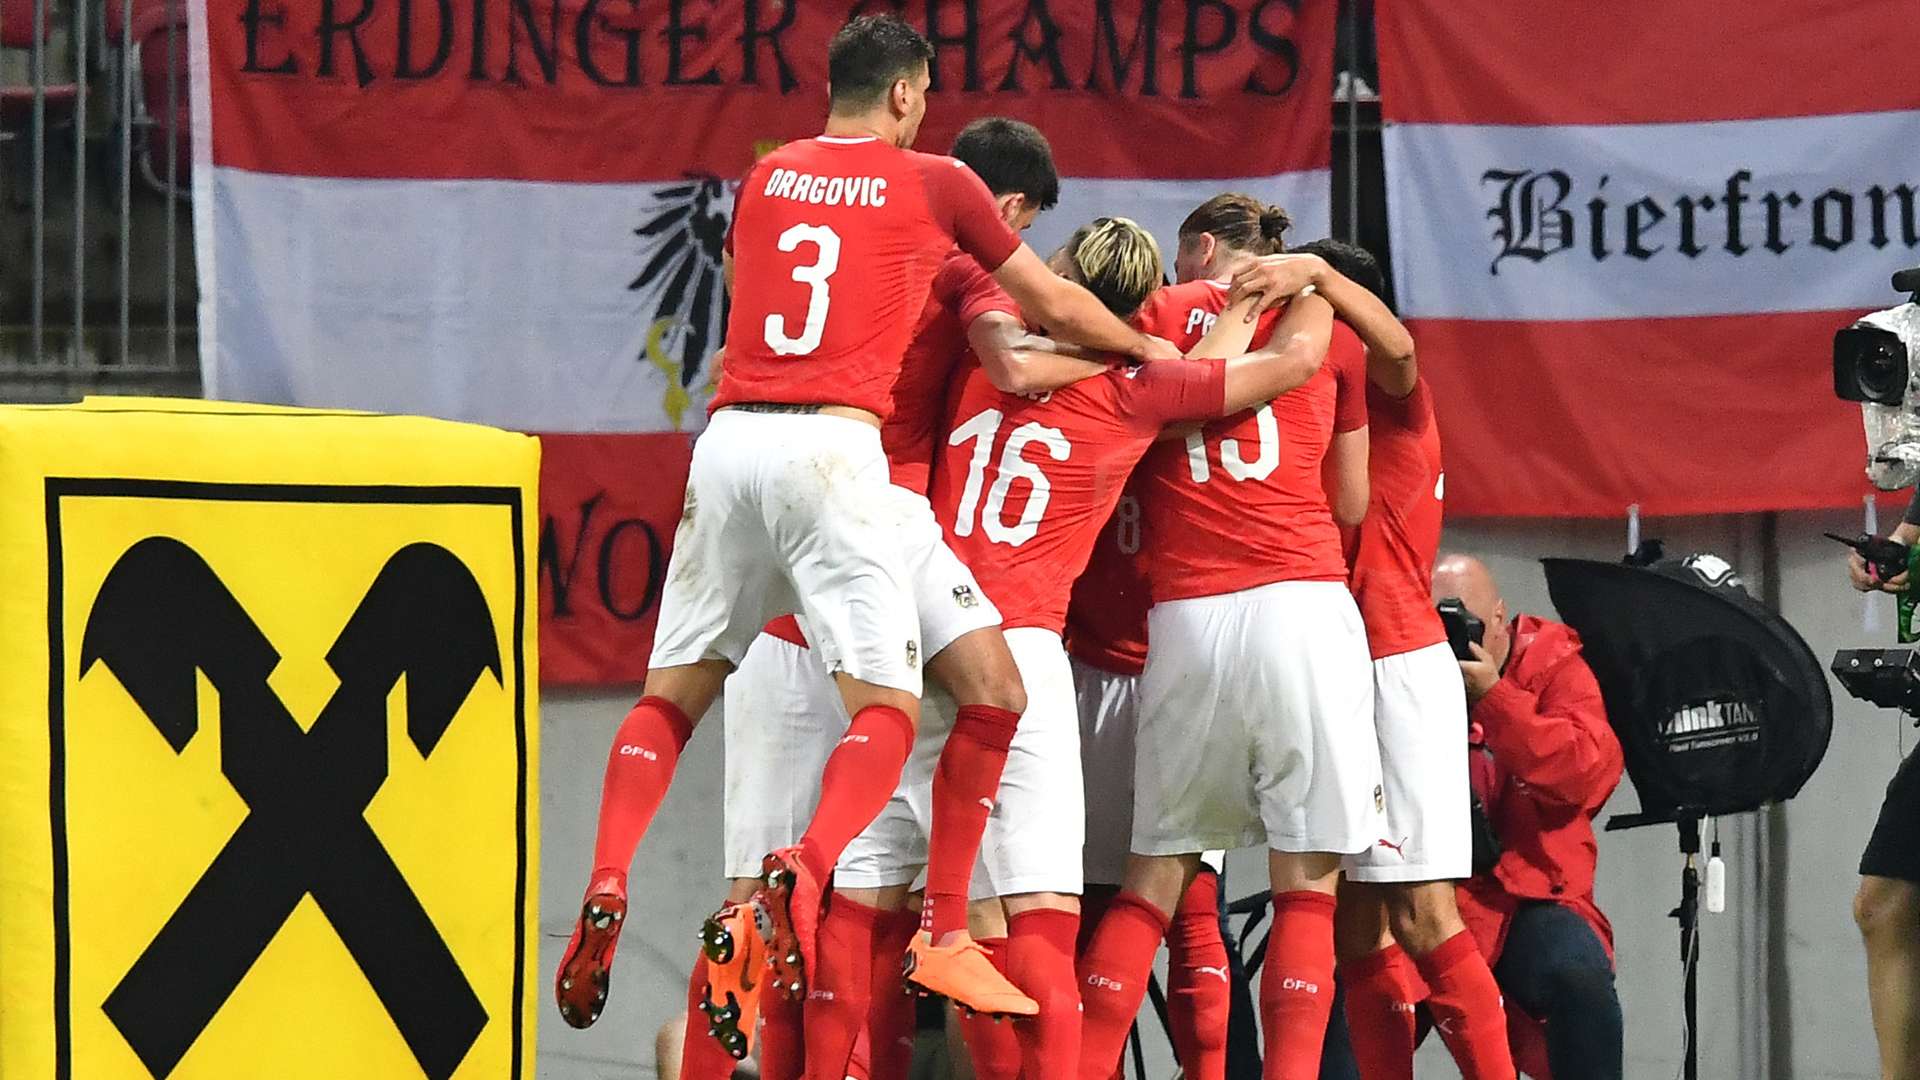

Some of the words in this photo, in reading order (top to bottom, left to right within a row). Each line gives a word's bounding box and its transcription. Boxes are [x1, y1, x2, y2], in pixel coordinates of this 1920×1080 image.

[240, 0, 799, 95] ERDINGER
[849, 0, 1299, 98] HAMPS
[763, 168, 887, 207] DRAGOVIC
[763, 222, 841, 356] 3
[1185, 308, 1217, 336] PR
[948, 408, 1070, 546] 16
[1117, 495, 1140, 554] 8
[538, 489, 663, 622] WO
